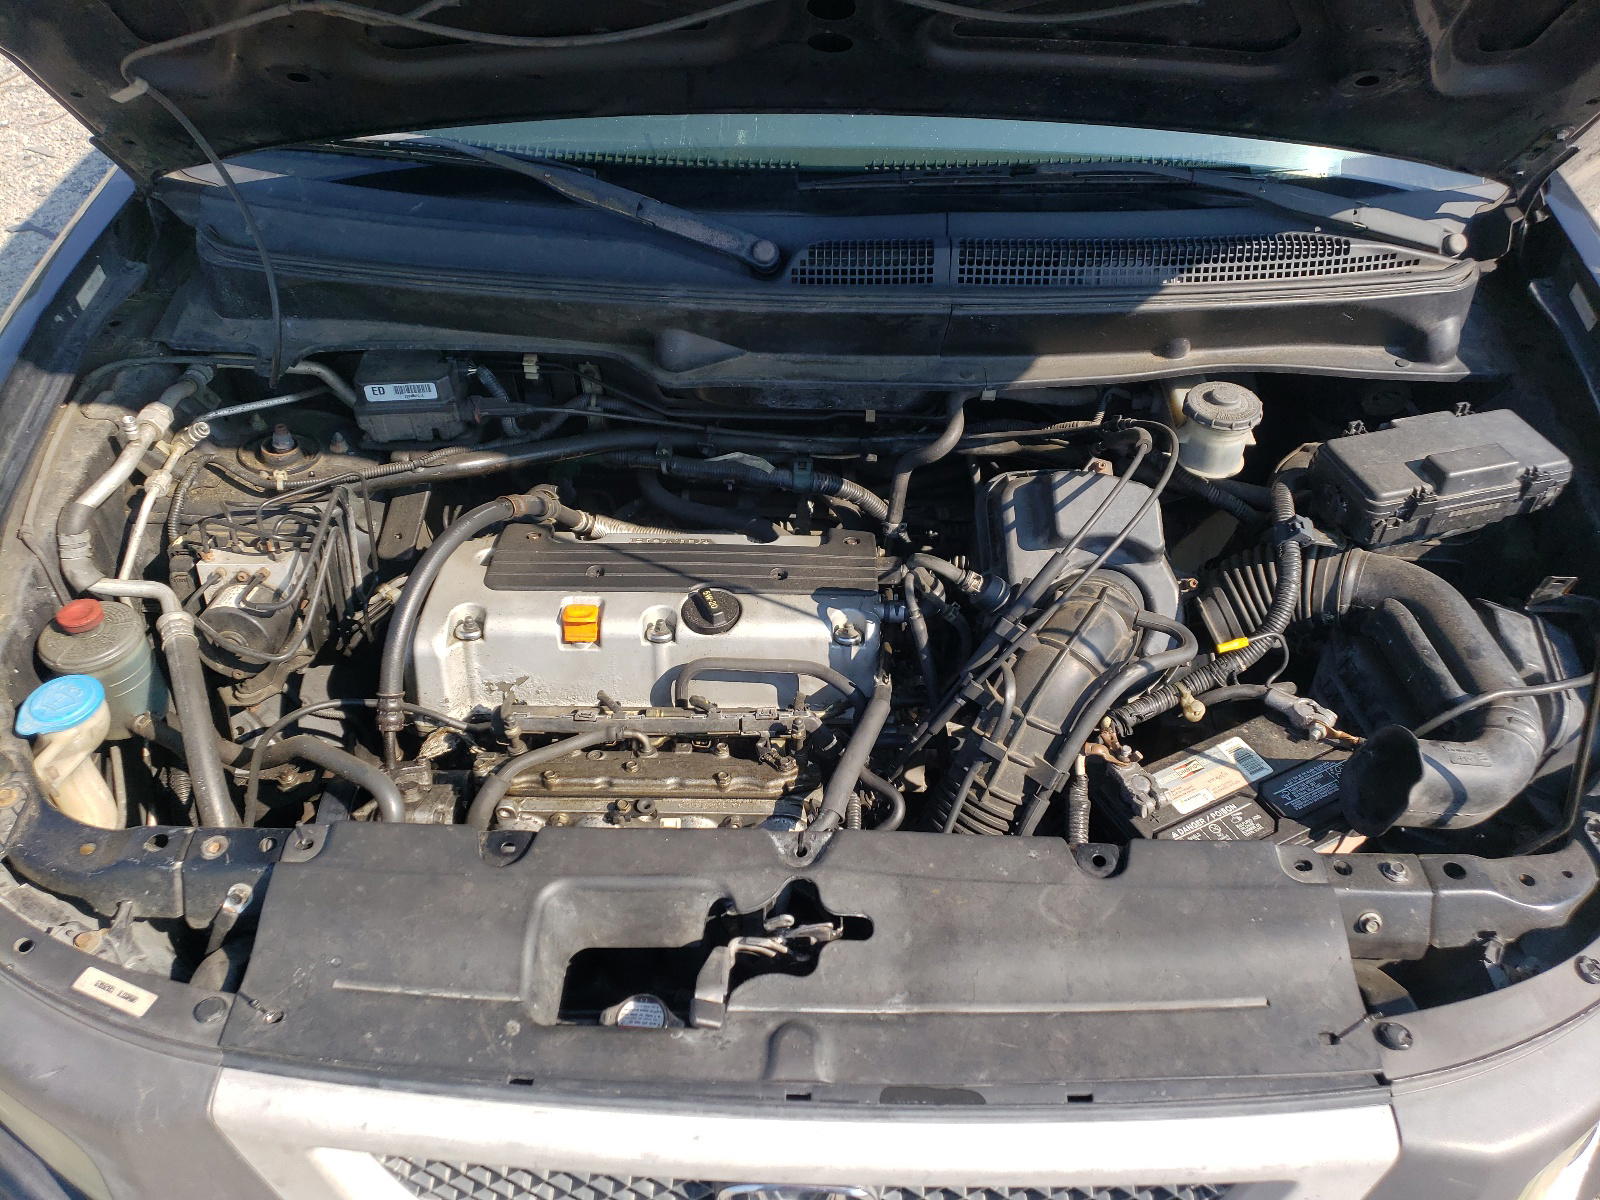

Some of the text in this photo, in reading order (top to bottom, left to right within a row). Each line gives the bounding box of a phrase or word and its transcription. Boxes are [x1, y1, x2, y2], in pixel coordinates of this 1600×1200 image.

[371, 386, 385, 396] ED
[702, 590, 719, 609] 5W-20
[1177, 817, 1207, 836] DANGER
[1210, 803, 1238, 818] POISON
